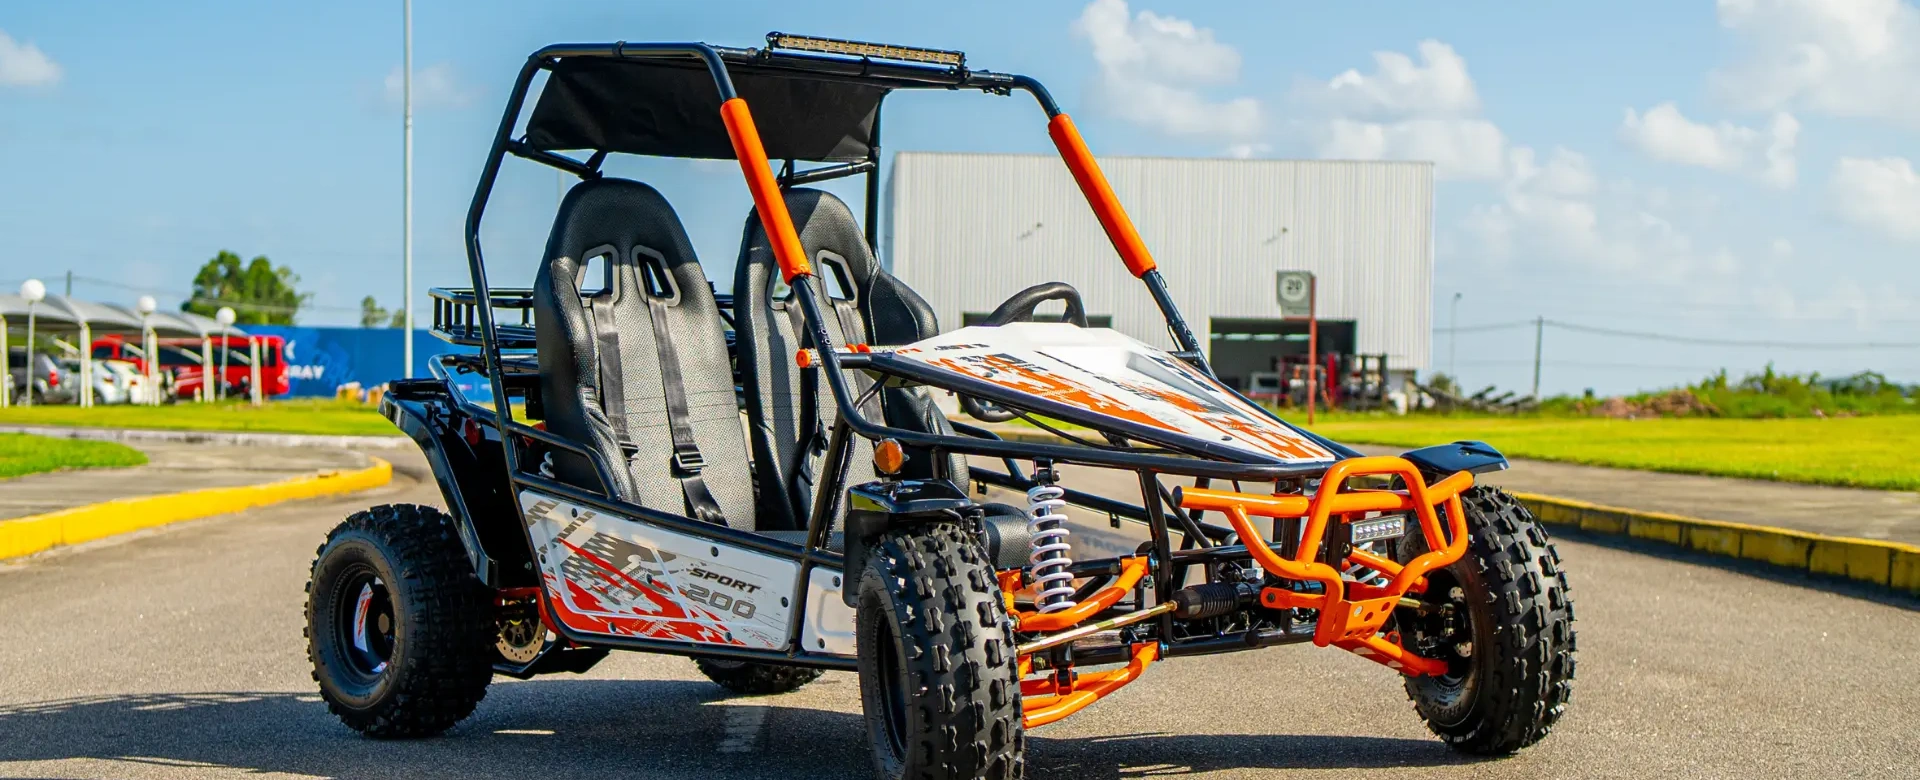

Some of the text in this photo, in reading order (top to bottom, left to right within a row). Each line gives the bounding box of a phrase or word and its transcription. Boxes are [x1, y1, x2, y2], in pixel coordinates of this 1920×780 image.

[1287, 279, 1302, 290] 20
[689, 567, 761, 594] SPORT
[686, 583, 756, 619] 200
